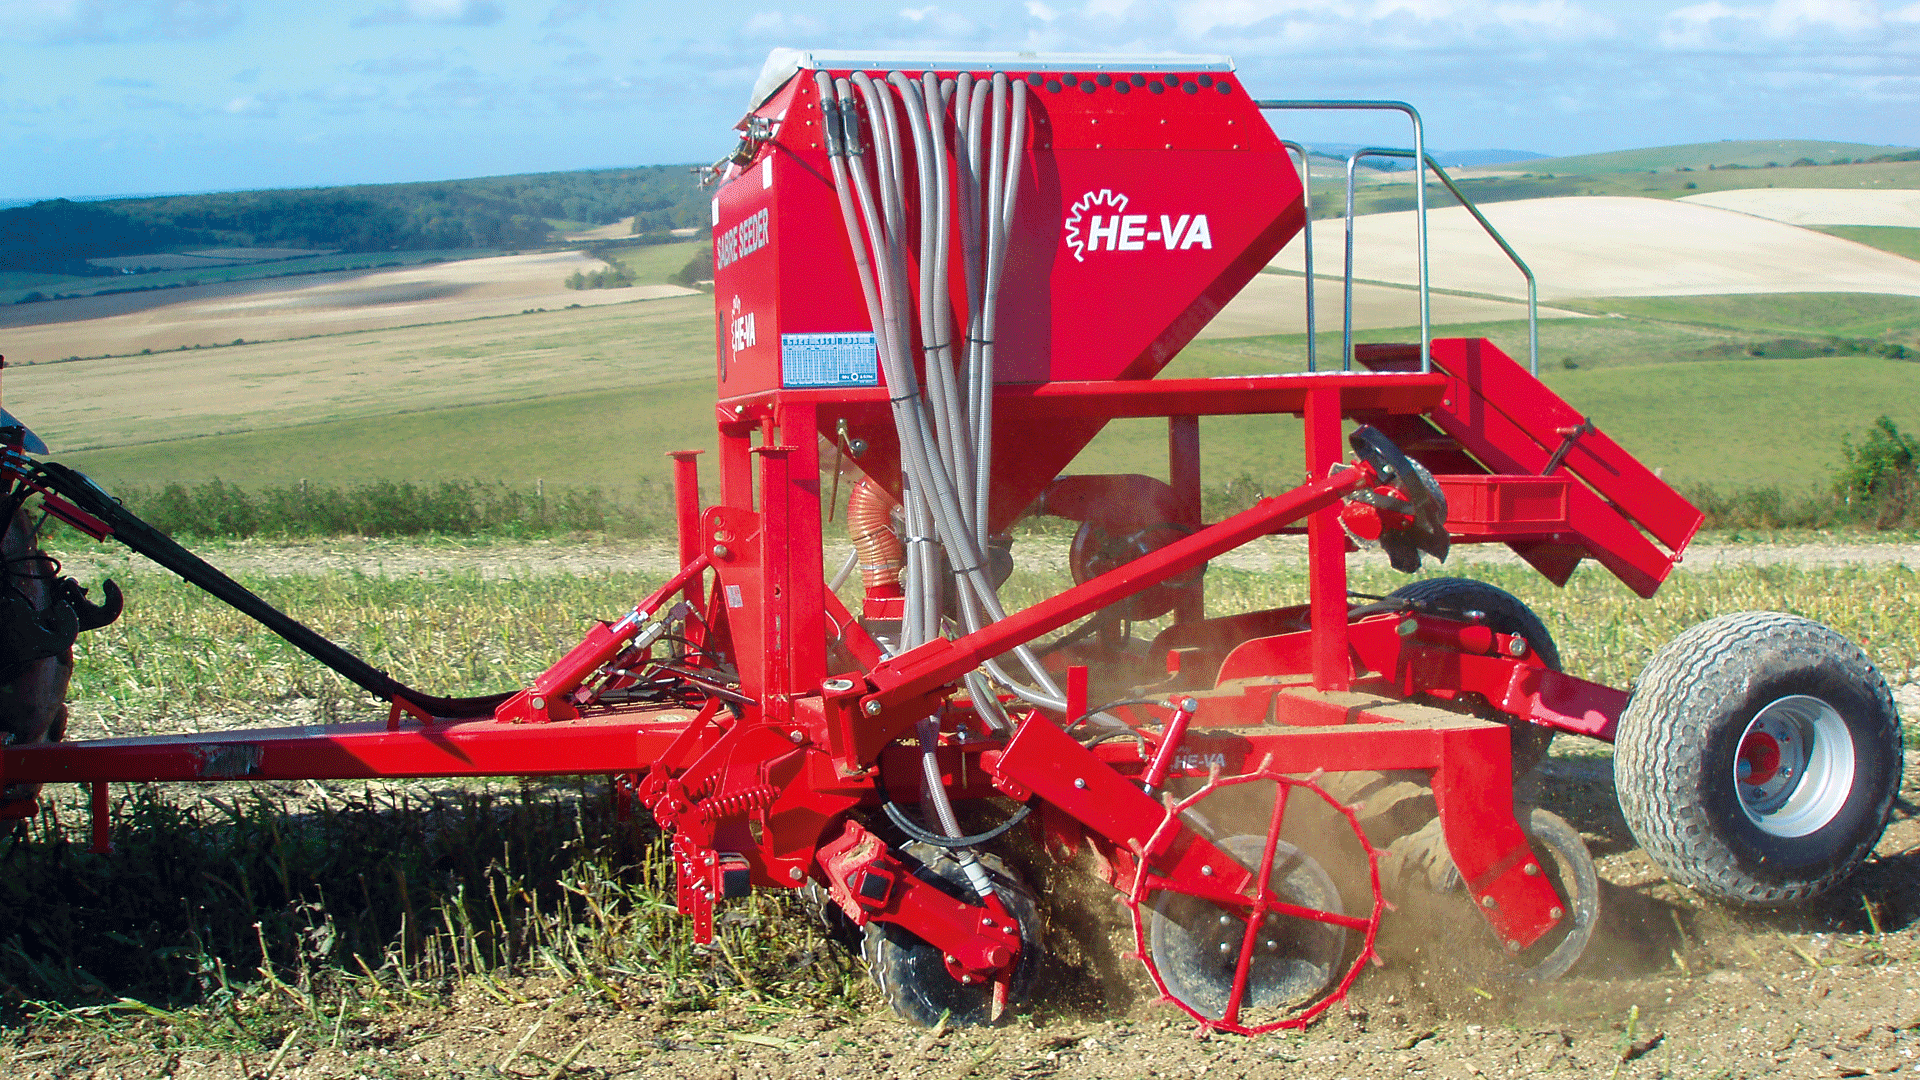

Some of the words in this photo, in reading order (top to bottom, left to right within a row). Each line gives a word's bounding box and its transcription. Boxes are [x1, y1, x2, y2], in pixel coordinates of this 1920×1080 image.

[717, 225, 738, 271] SABRE
[739, 207, 769, 258] SEEDER
[1087, 214, 1213, 251] HE-VA
[734, 312, 756, 352] HE-VA
[1173, 752, 1226, 770] HE-VA
